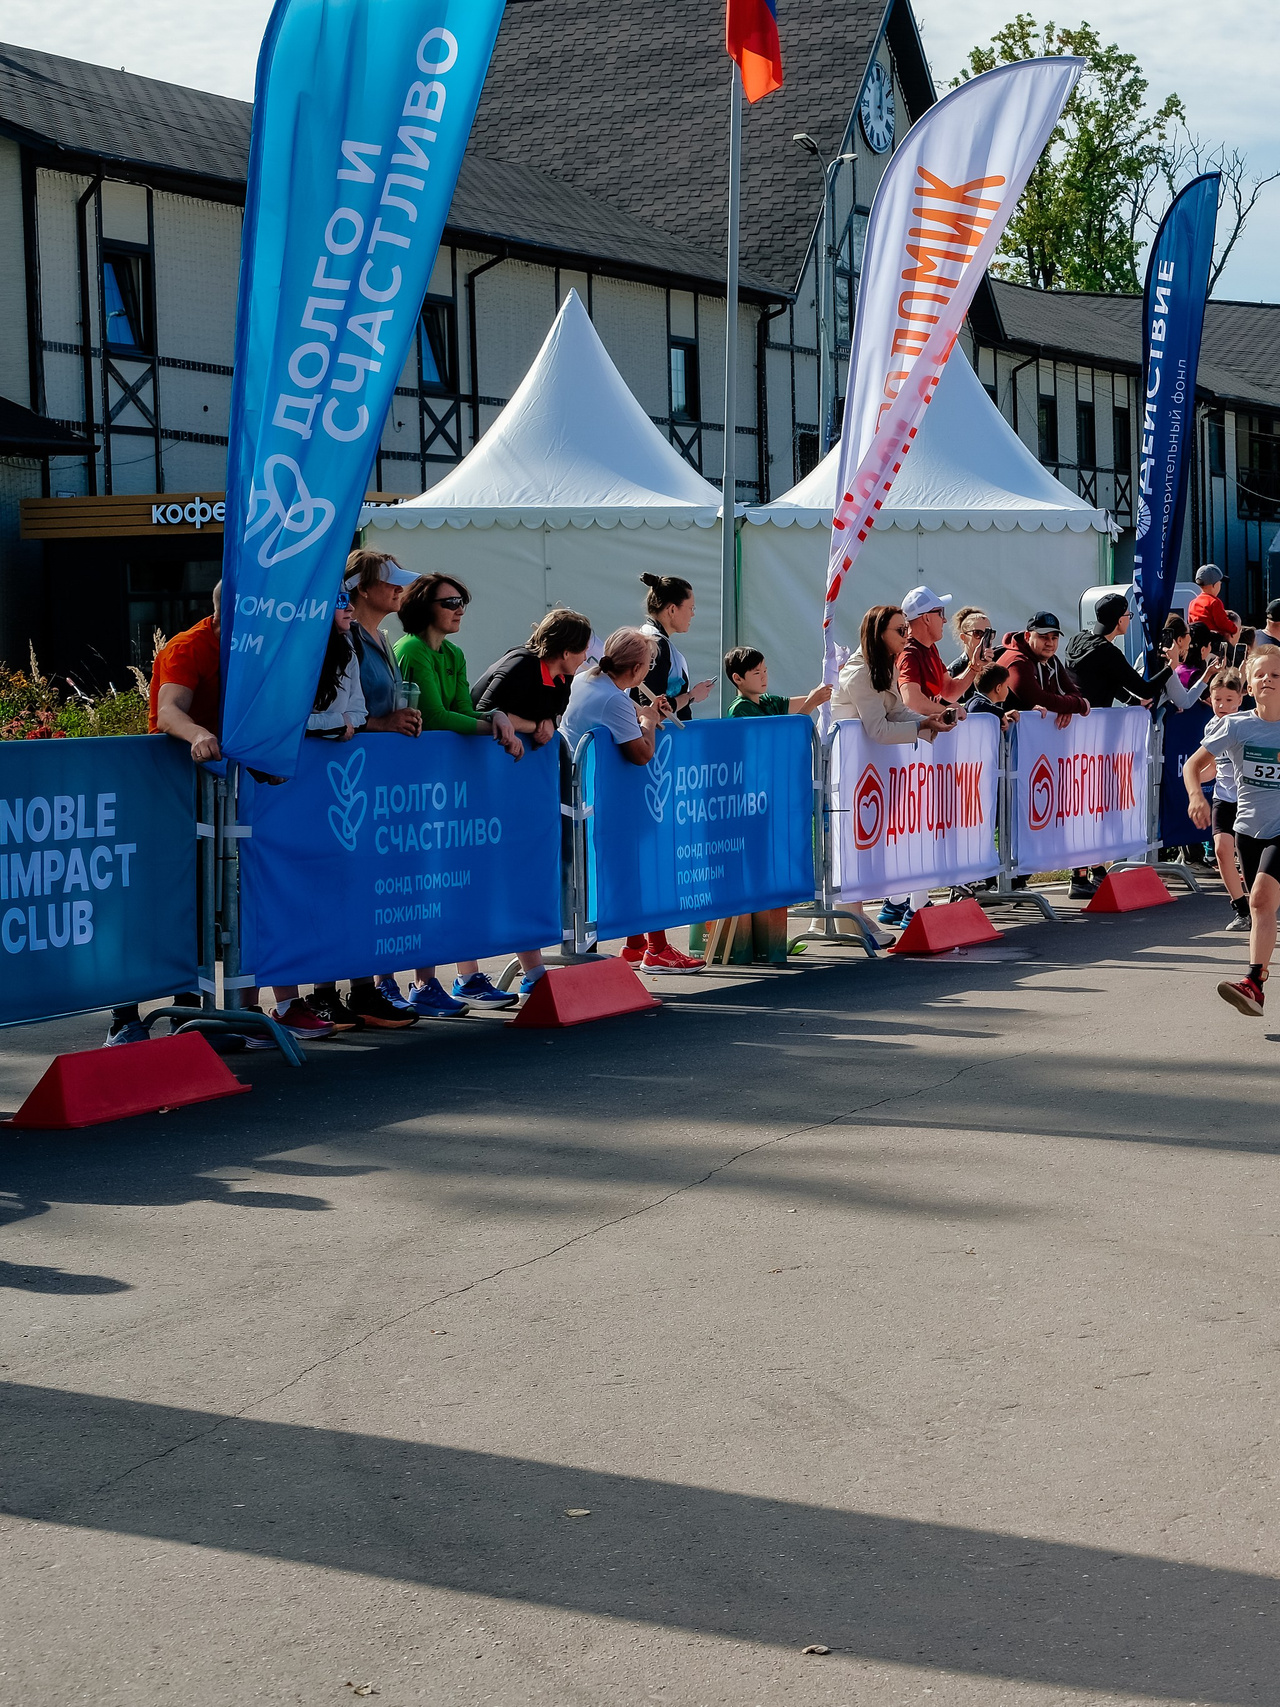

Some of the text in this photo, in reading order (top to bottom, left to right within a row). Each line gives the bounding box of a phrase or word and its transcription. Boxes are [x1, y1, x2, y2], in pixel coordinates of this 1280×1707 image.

[321, 26, 459, 443] СЧАСТЛИВО
[273, 139, 383, 440] ДОЛГО И
[674, 760, 744, 795] ДОЛГО И
[1055, 751, 1136, 829] ДОБРОДОМИК
[0, 793, 117, 845] NOBLE
[373, 780, 468, 821] ДОЛГО И
[675, 790, 768, 825] СЧАСТЛИВО
[886, 761, 984, 847] ДОБРОДОМИК
[374, 816, 502, 855] СЧАСТЛИВО
[676, 837, 746, 861] ФОНД ПОМОЩИ
[0, 843, 137, 900] IMPACT
[374, 870, 471, 896] ФОНД ПОМОЩИ
[677, 865, 725, 886] ПОЖИЛЫМ
[374, 901, 442, 926] ПОЖИЛЫМ
[679, 891, 713, 912] ЛЮДЯМ
[1, 900, 94, 954] CLUB
[374, 934, 422, 957] ЛЮДЯМ
